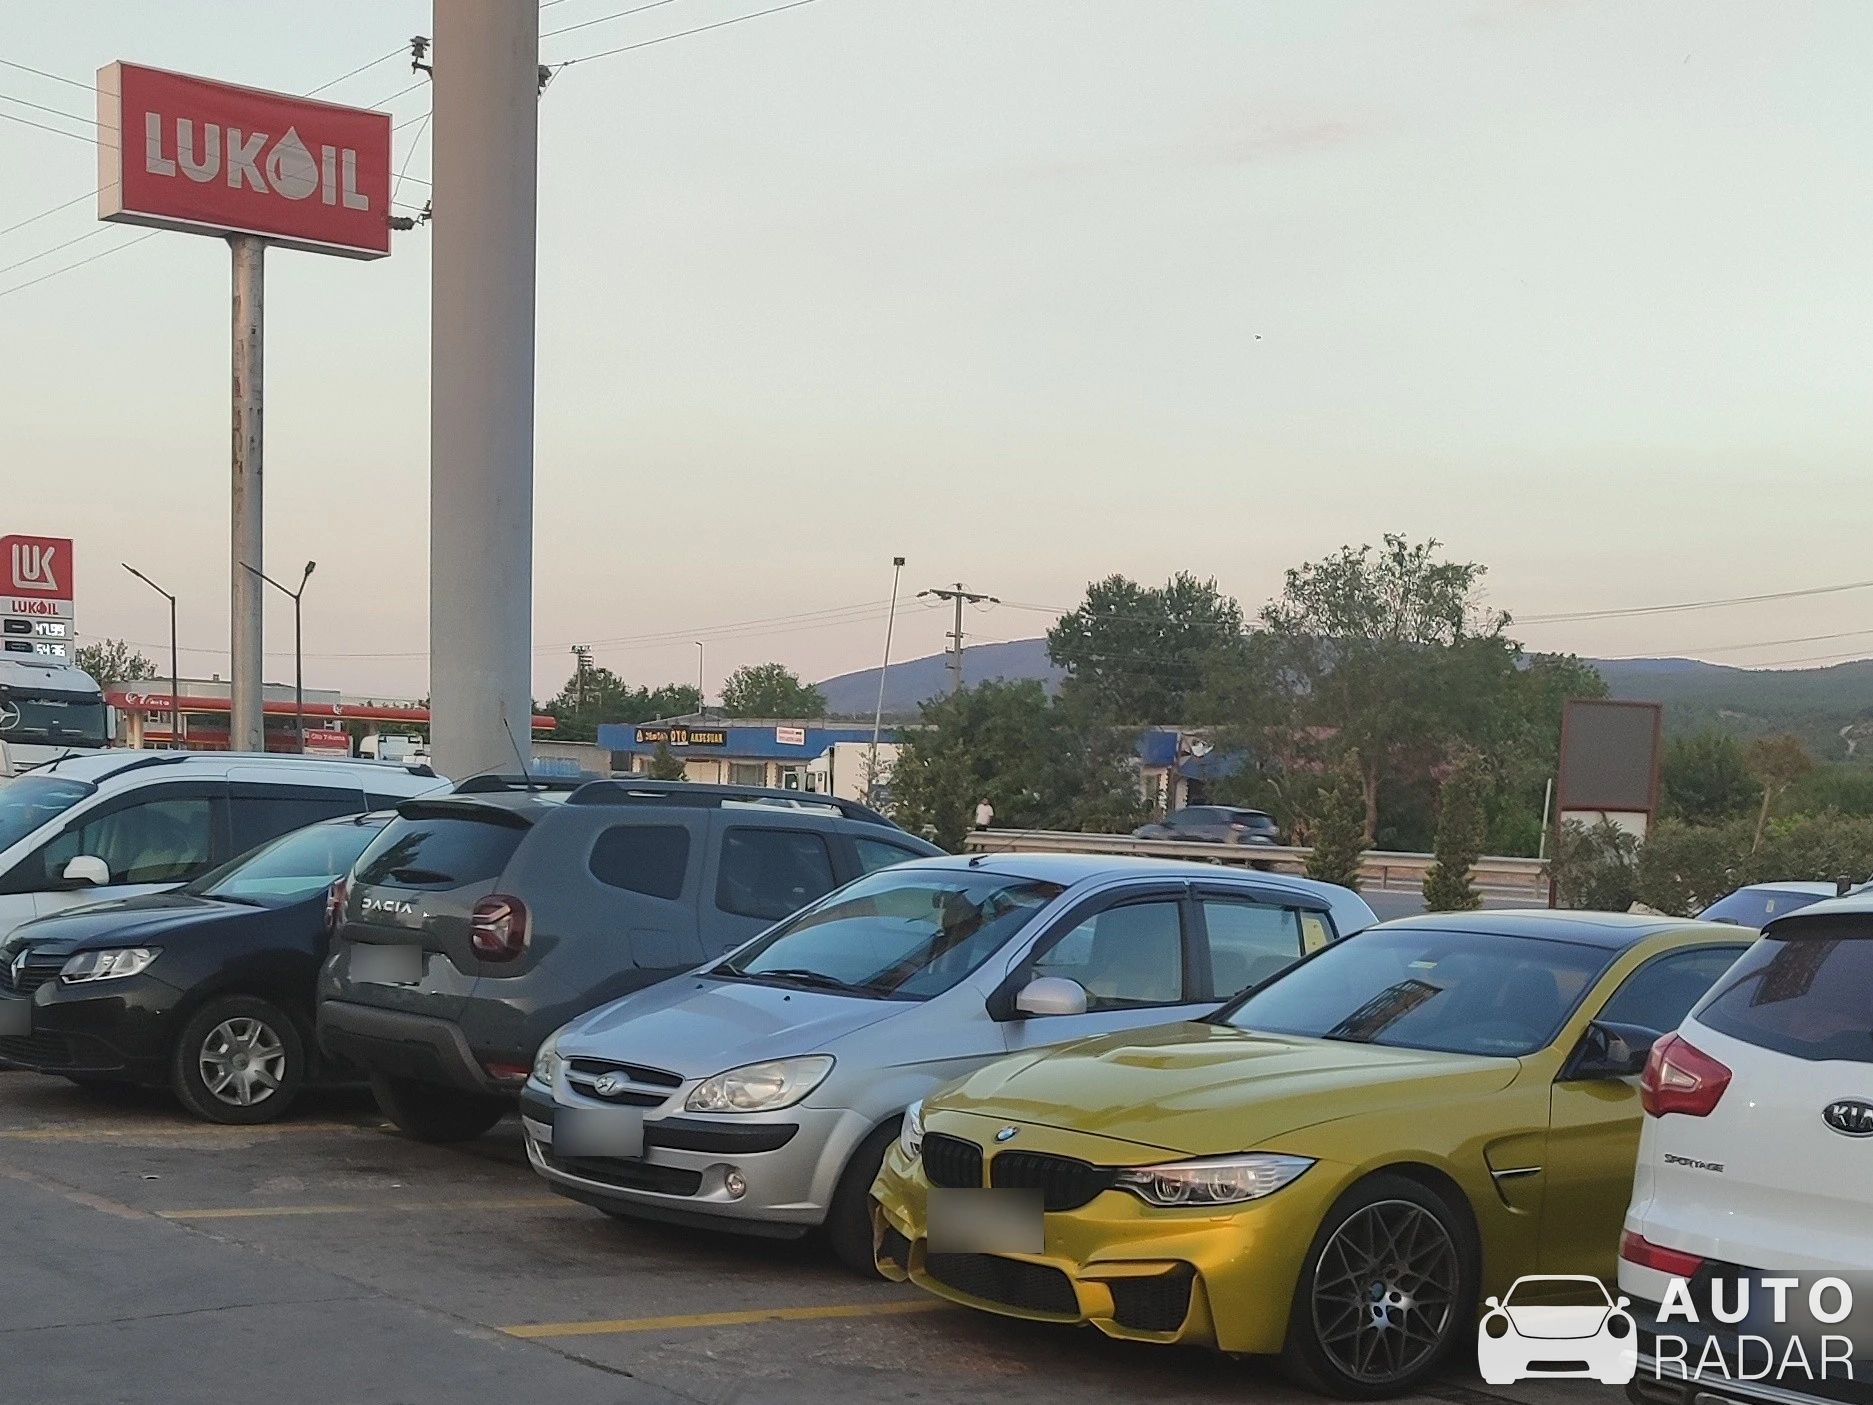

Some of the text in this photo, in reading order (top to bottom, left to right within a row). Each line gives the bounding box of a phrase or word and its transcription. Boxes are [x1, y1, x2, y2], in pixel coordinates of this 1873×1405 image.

[145, 111, 369, 211] LUKOIL
[12, 600, 59, 615] LUKOIL
[361, 897, 413, 914] DACIA
[1664, 1153, 1724, 1173] SPORTAGE
